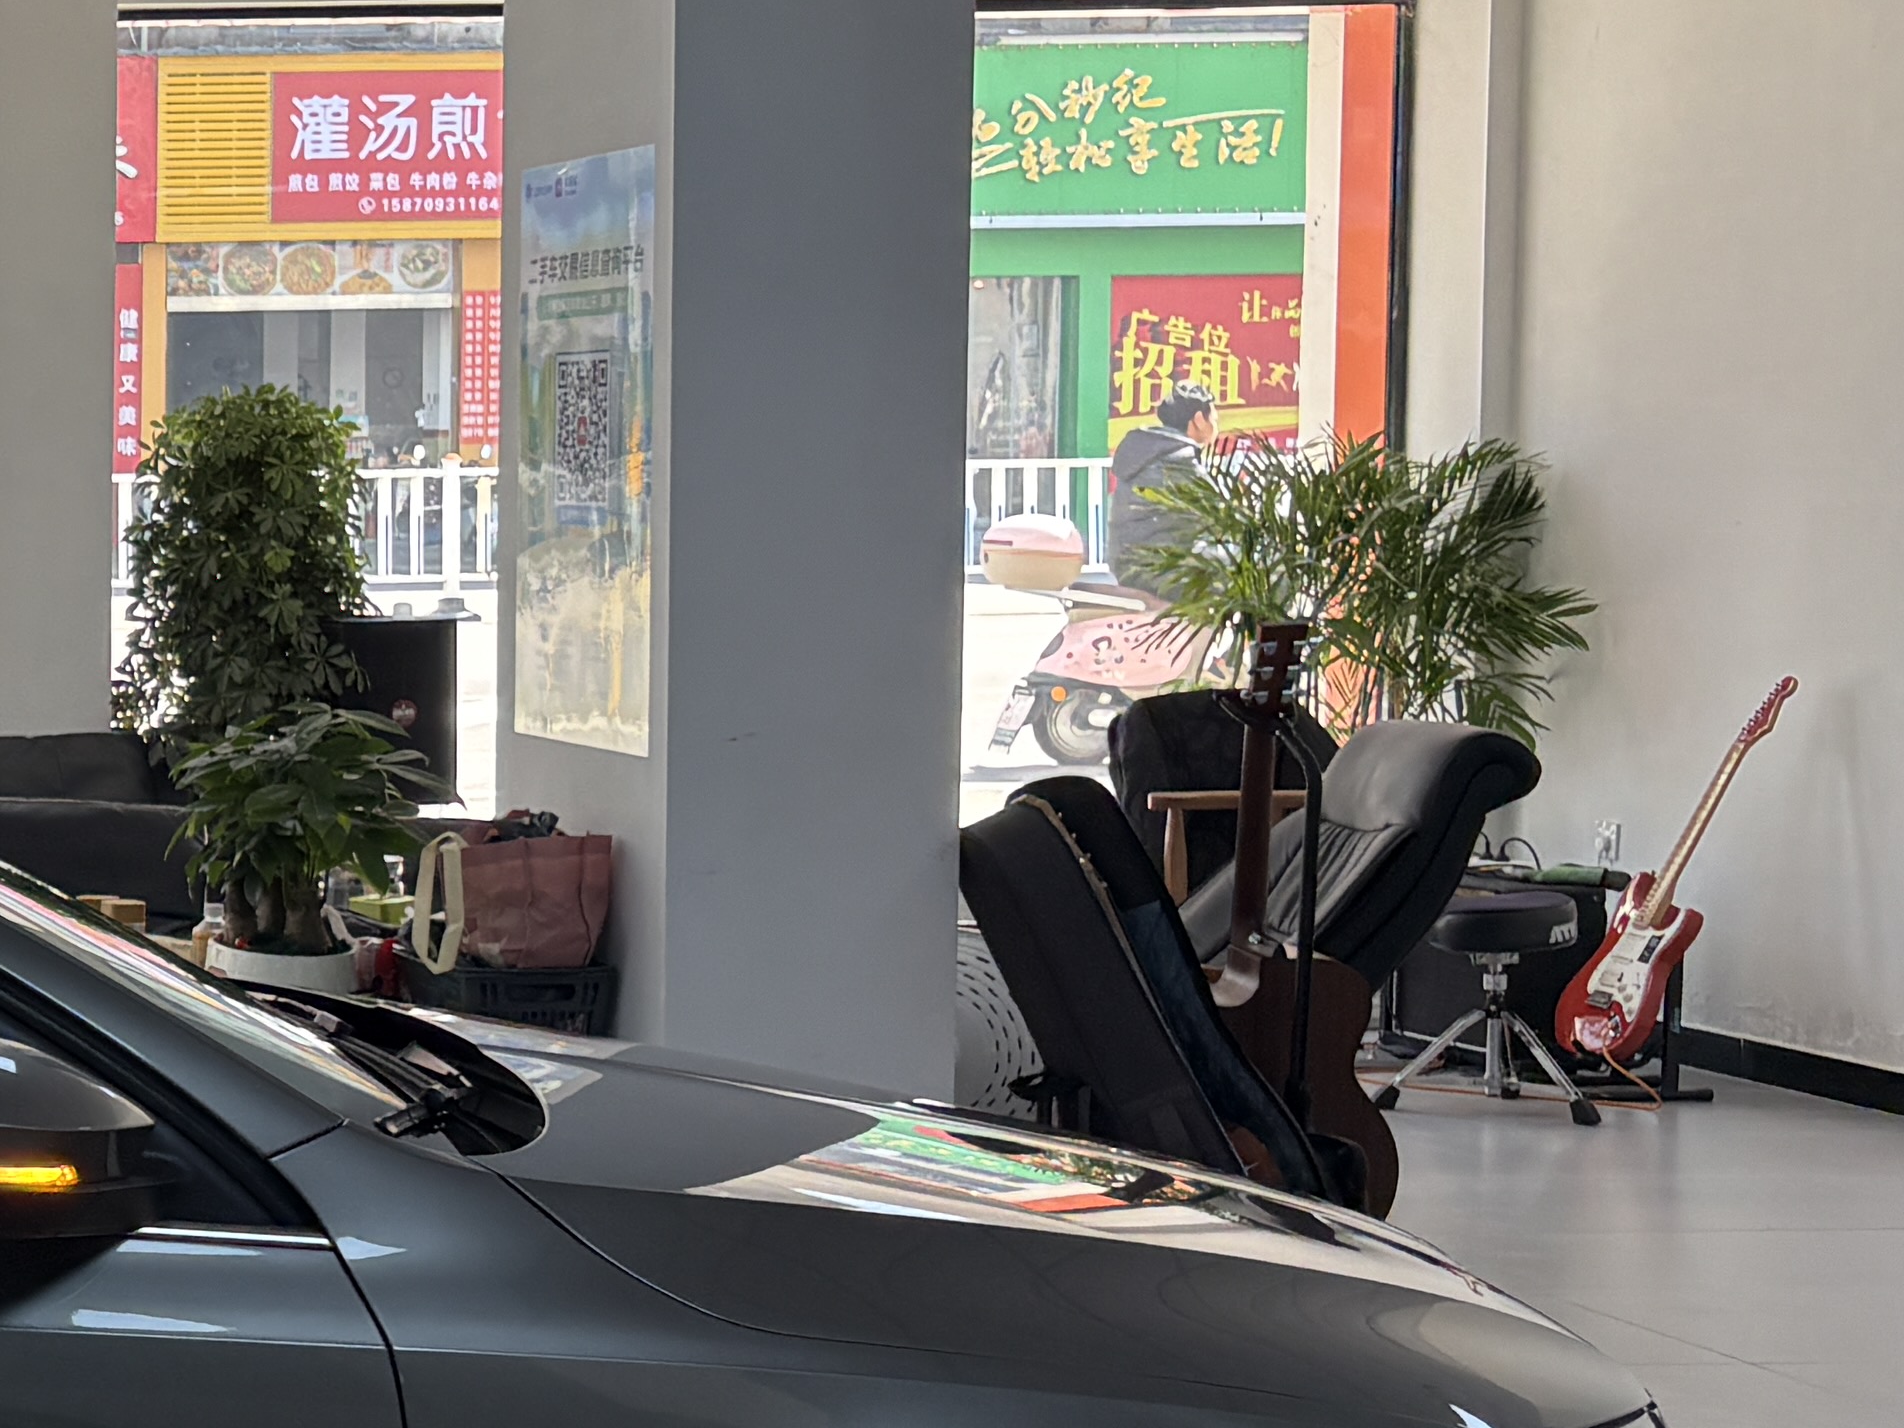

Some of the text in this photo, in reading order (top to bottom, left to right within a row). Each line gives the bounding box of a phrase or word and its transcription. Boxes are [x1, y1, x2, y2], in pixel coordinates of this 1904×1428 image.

[289, 92, 503, 161] 灌汤煎
[1127, 308, 1232, 355] 广告位
[1113, 336, 1247, 415] 招租
